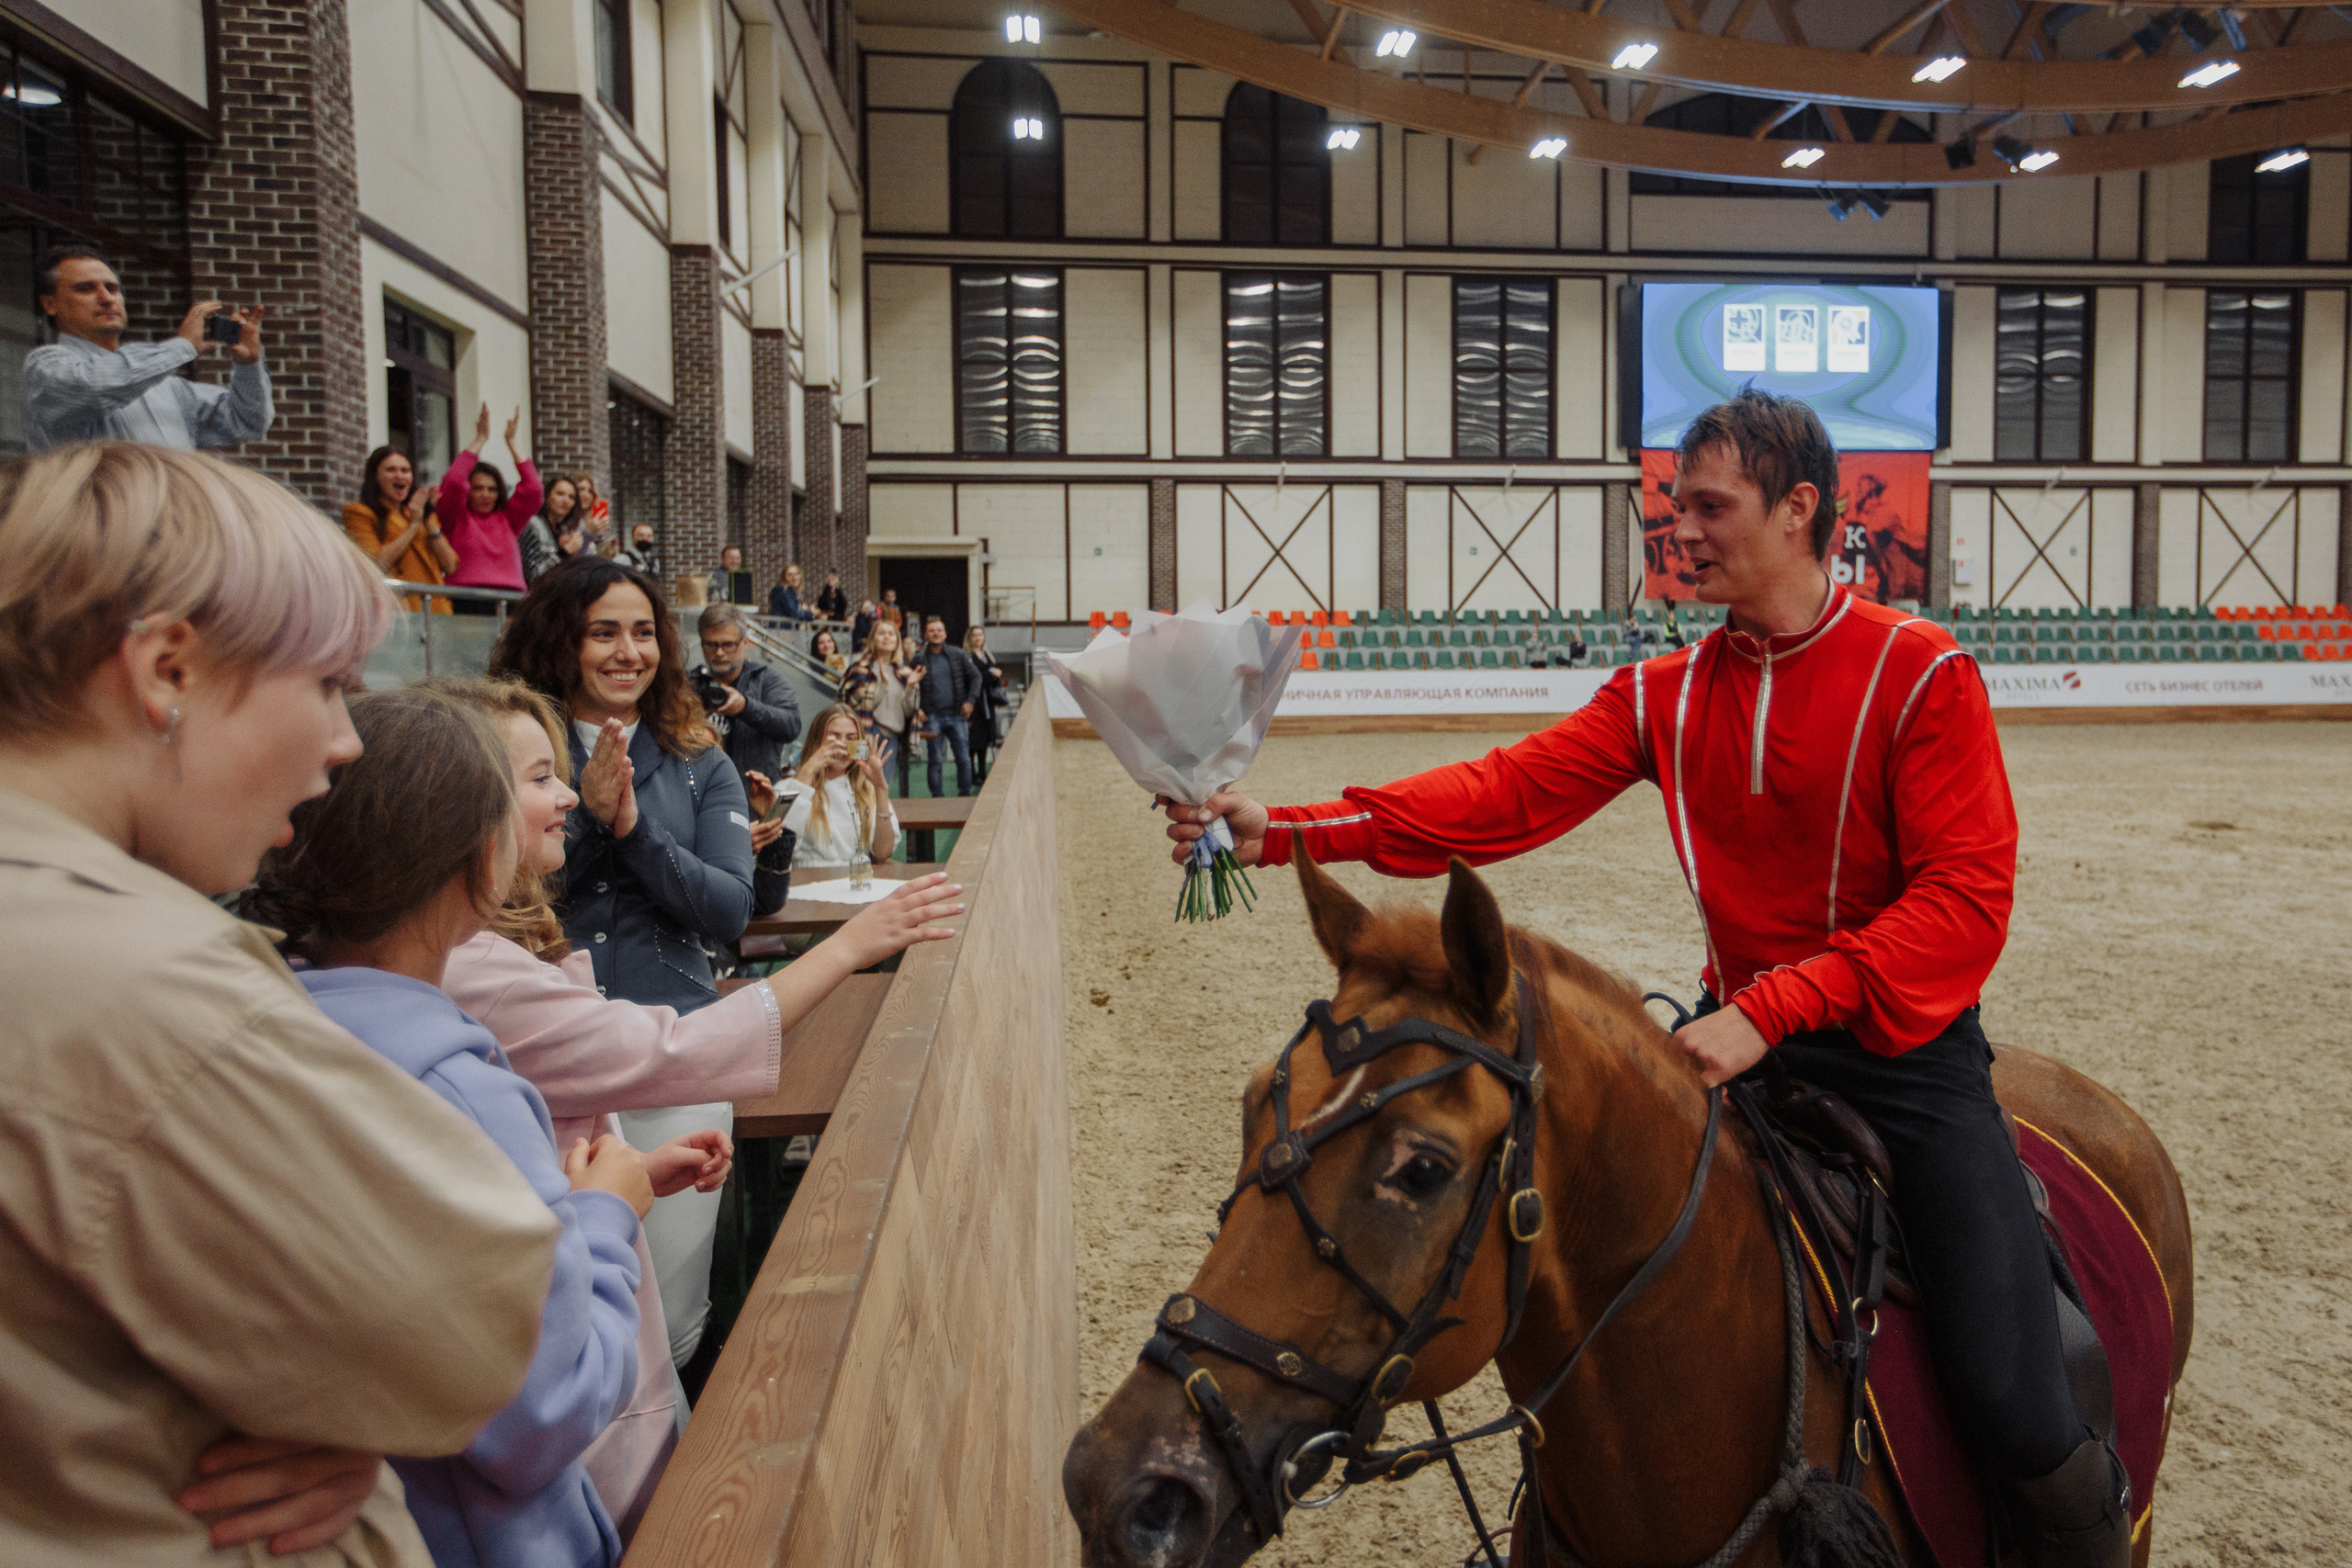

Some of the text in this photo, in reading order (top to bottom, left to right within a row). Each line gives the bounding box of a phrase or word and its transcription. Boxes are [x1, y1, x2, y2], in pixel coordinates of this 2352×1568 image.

[1984, 678, 2060, 691] MAXIMA
[2126, 682, 2156, 693] СЕТЬ
[1346, 688, 1462, 700] УПРАВЛЯЮЩАЯ
[1465, 687, 1548, 698] КОМПАНИЯ
